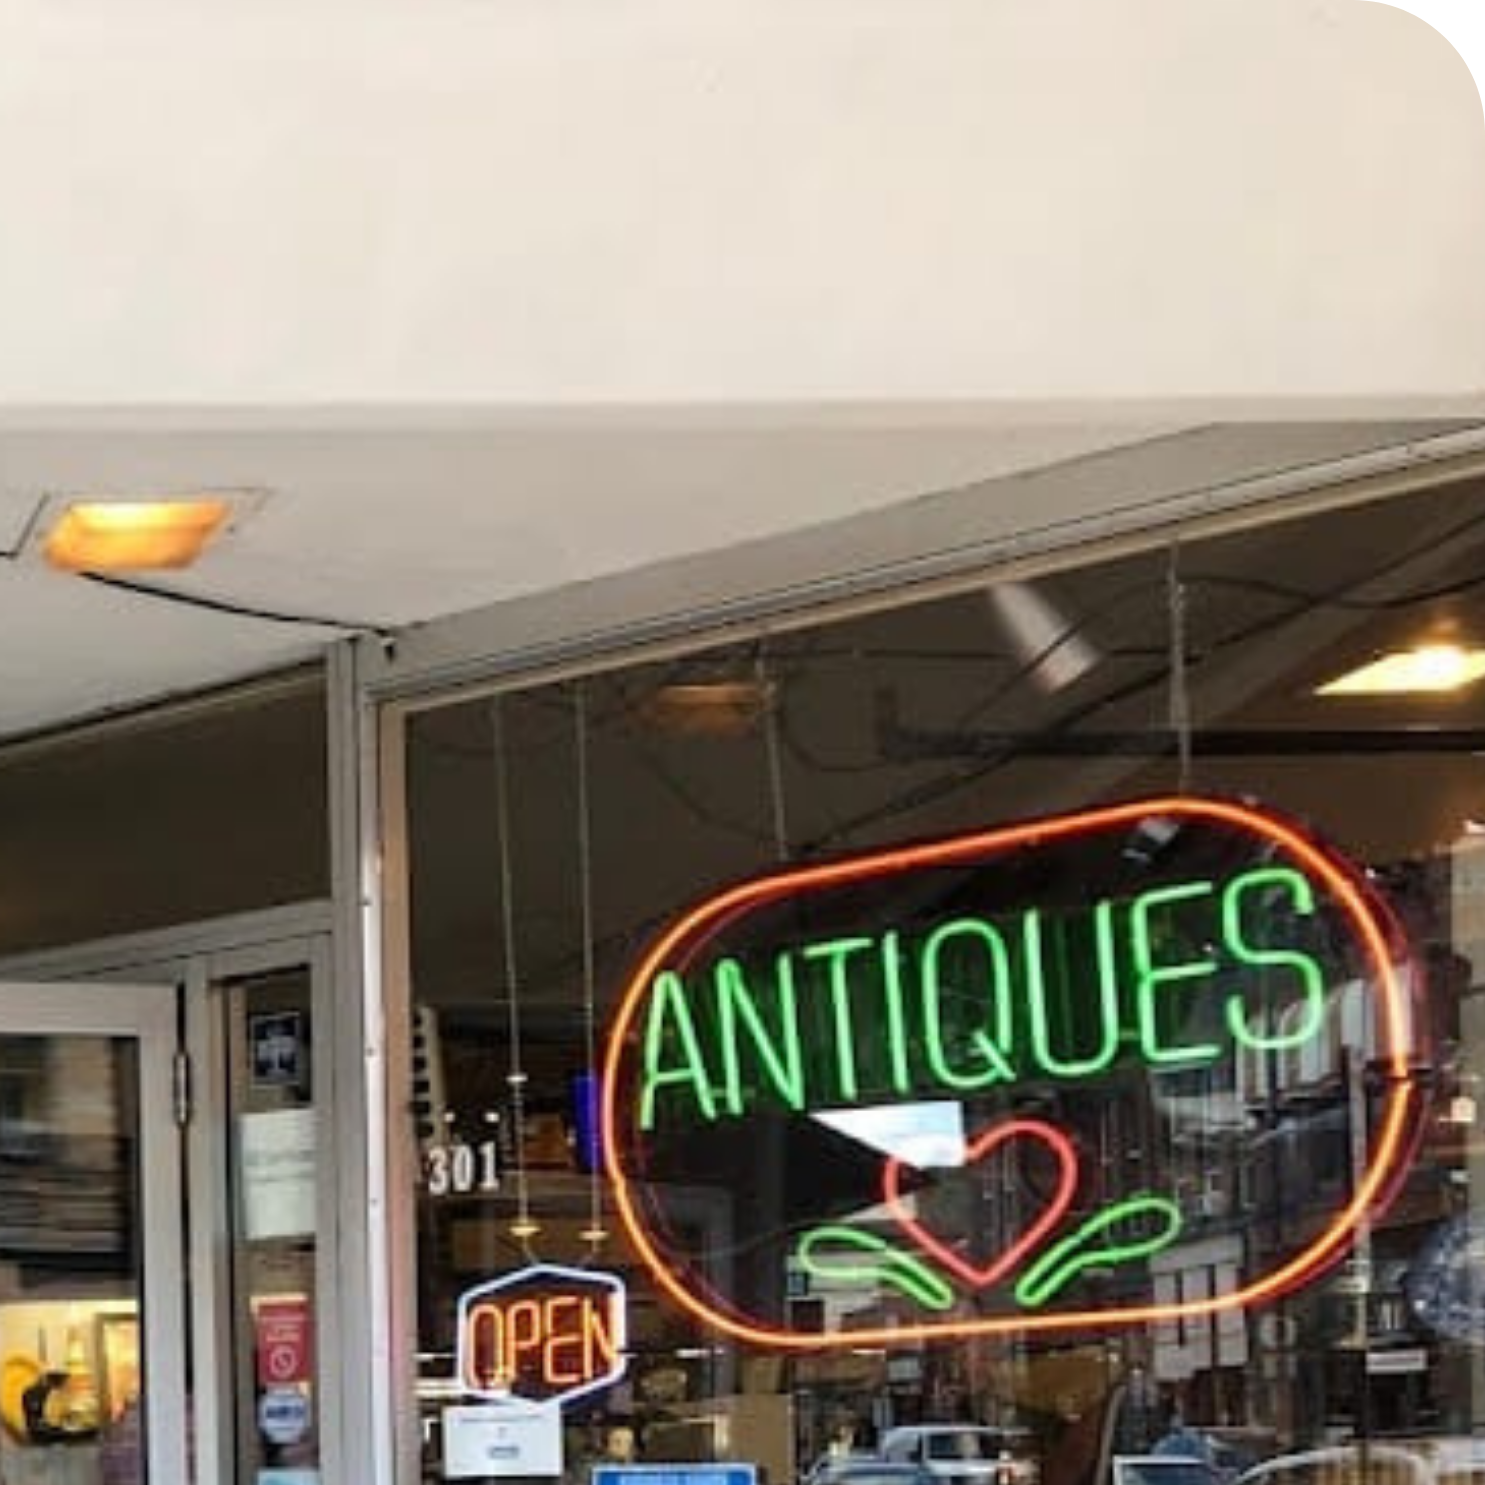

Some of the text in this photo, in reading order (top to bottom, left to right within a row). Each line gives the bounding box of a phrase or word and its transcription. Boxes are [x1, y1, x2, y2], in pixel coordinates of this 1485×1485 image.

[640, 868, 1320, 1128] ANTIQUES
[428, 1142, 501, 1195] 301
[467, 1296, 618, 1390] OPEN
